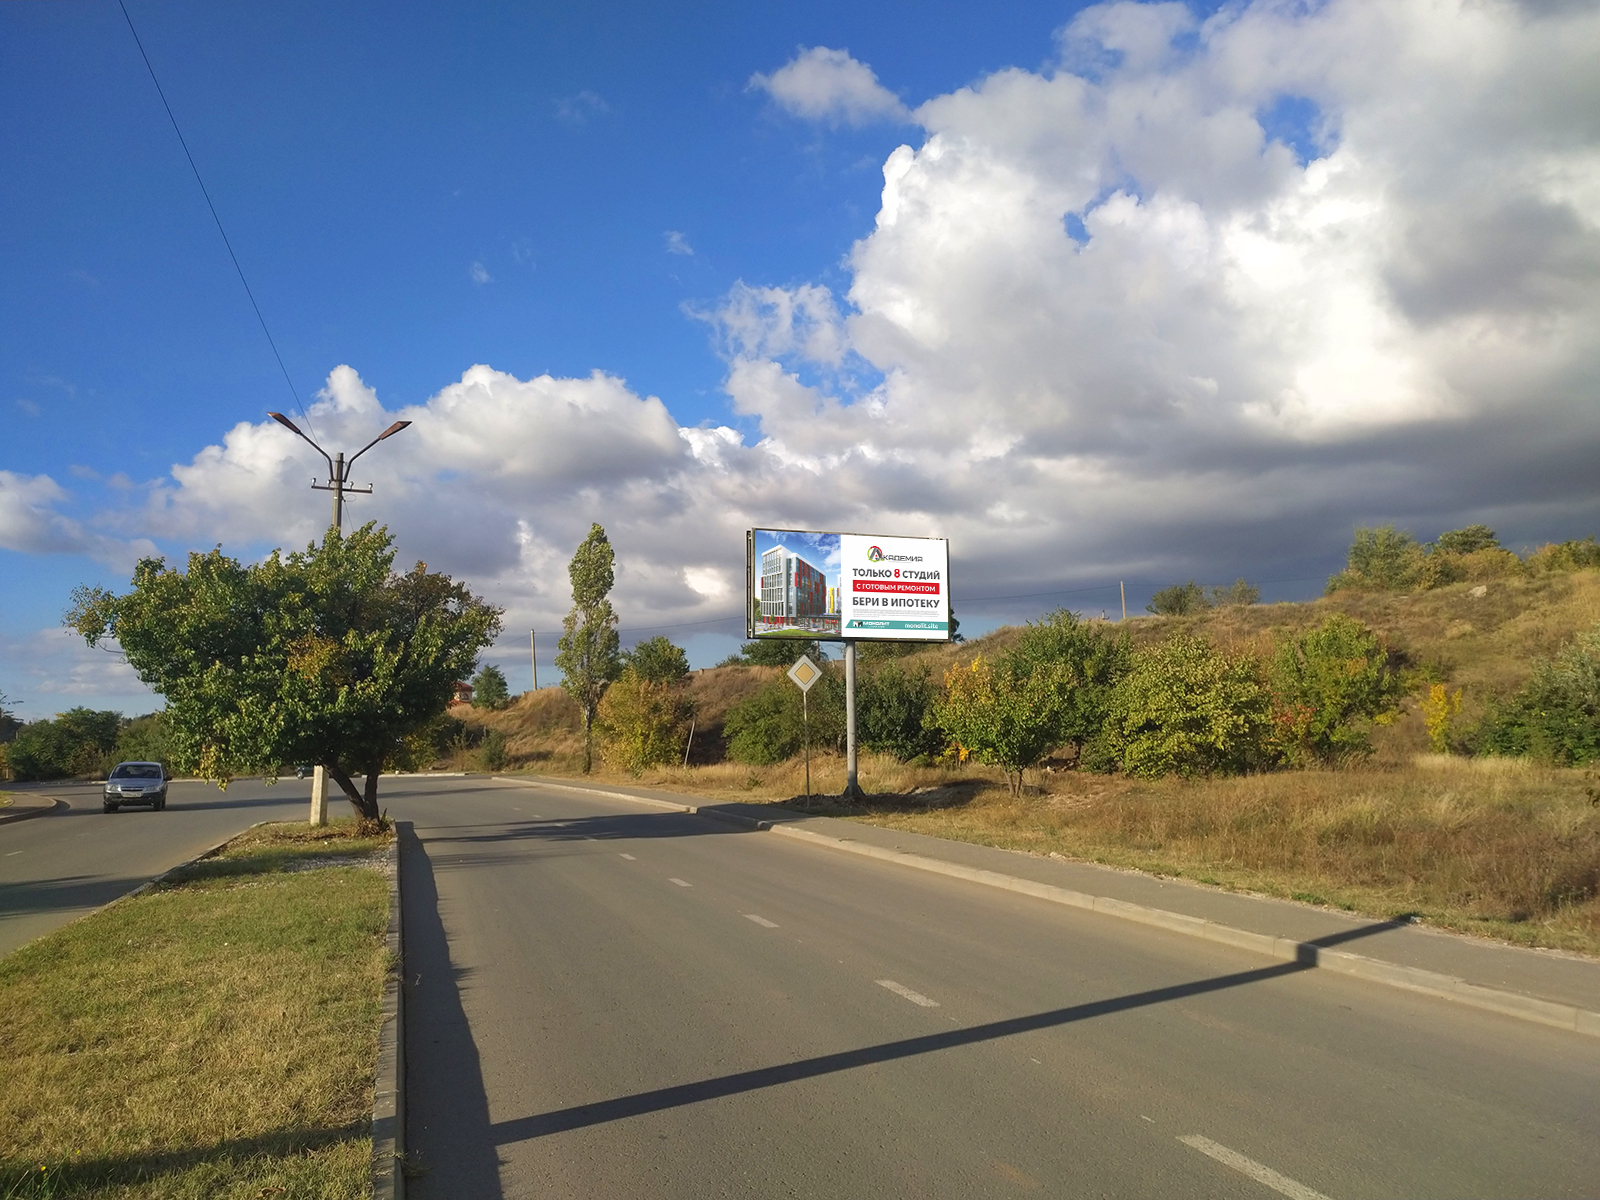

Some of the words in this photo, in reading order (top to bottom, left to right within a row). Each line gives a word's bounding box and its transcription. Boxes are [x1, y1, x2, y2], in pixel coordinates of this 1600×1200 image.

[852, 568, 892, 578] ТОЛЬКО
[894, 568, 901, 578] 8
[902, 570, 940, 580] СТУДИЙ
[852, 596, 879, 606] БЕРИ
[882, 597, 889, 607] В
[891, 598, 940, 608] ИПОТЕКУ
